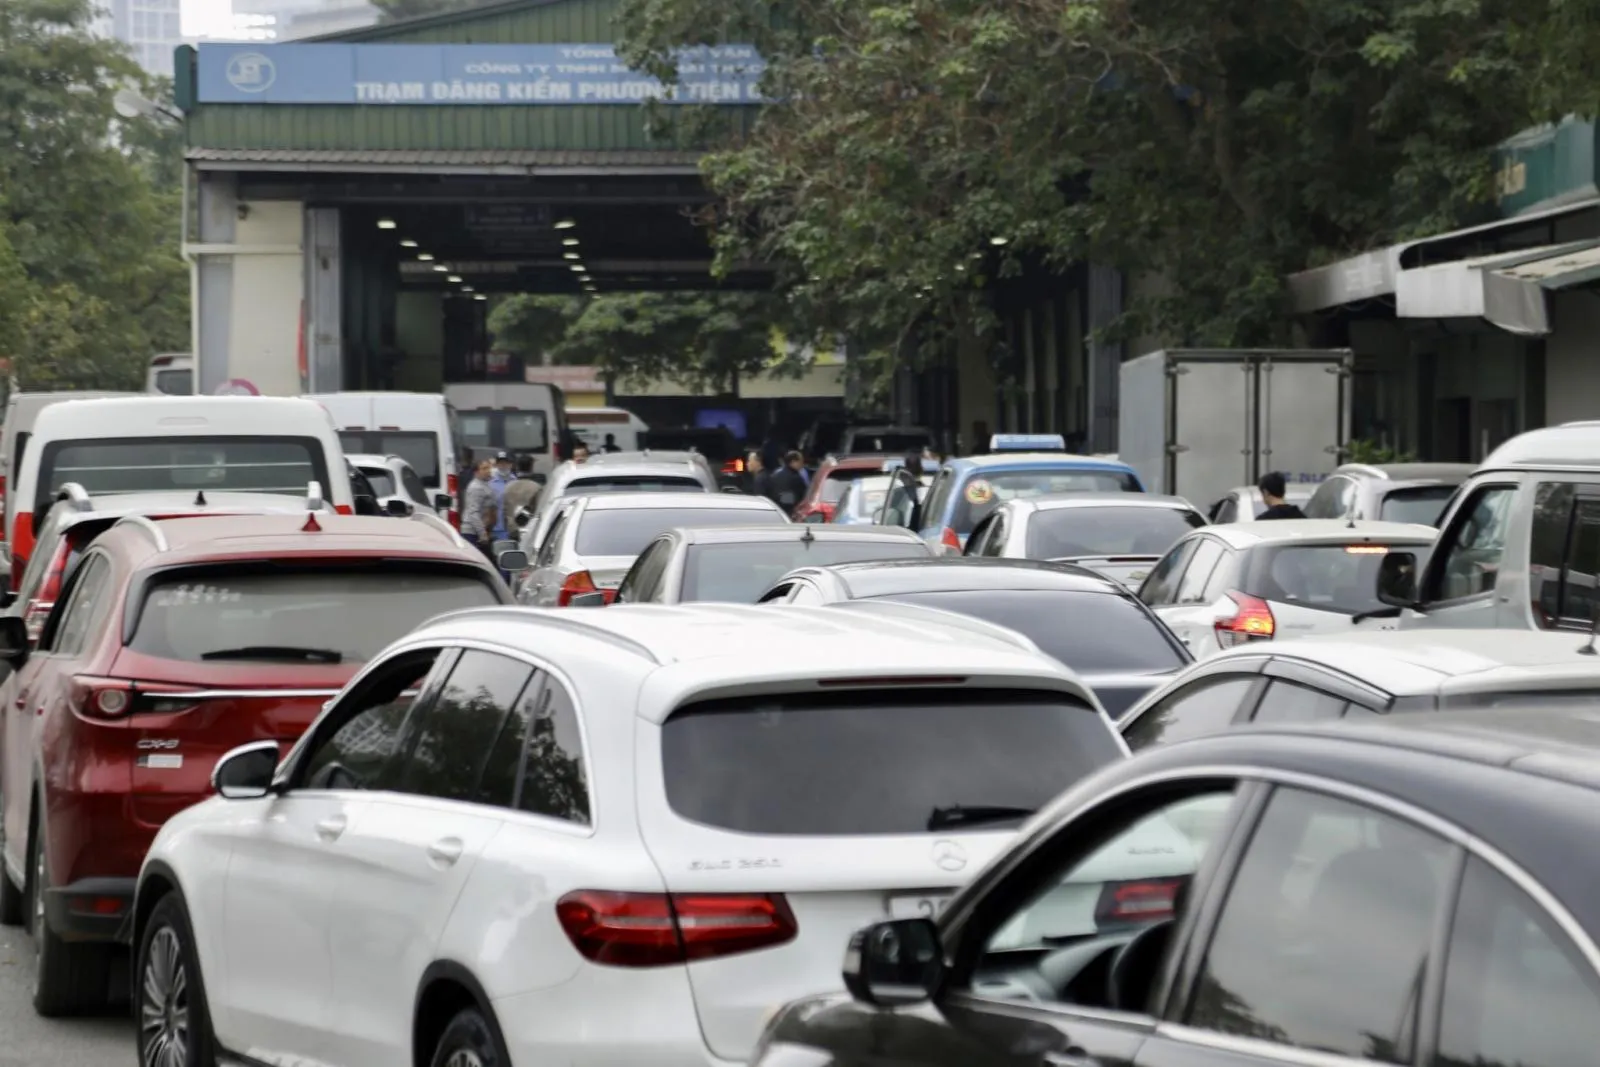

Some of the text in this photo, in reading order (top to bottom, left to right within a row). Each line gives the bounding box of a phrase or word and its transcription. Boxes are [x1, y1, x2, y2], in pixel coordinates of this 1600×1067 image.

[464, 61, 521, 74] CÔNG
[524, 63, 550, 73] TY
[556, 63, 605, 73] TNHH
[355, 81, 423, 102] TRẠM
[432, 78, 500, 100] ĐĂNG
[507, 76, 571, 100] KIỂM
[685, 79, 739, 102] TIỆN
